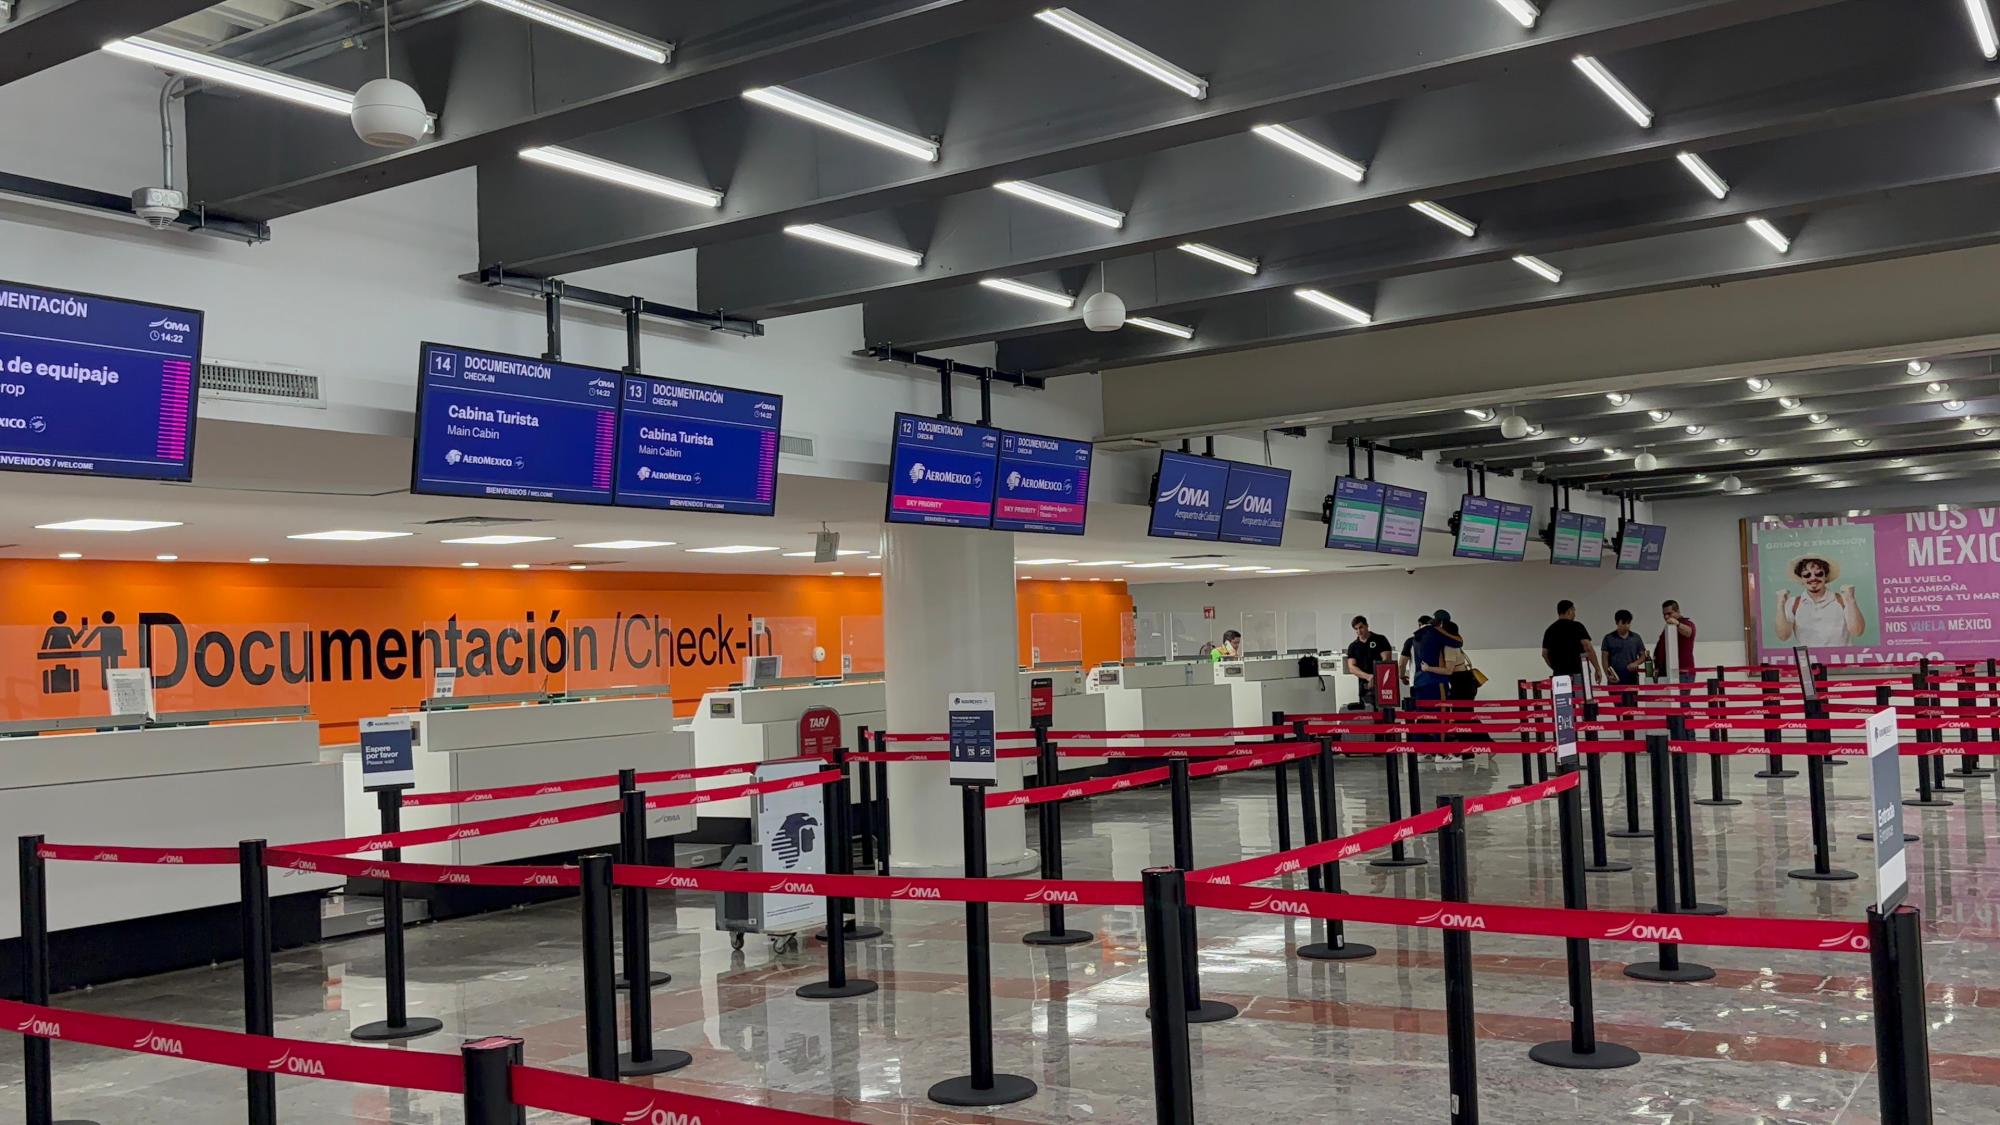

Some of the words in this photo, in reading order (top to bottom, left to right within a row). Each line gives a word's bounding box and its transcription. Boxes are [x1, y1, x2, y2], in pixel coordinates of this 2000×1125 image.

[164, 321, 190, 332] OMA
[161, 333, 184, 343] 14:22
[435, 356, 450, 371] 14
[464, 356, 551, 380] DOCUMENTACIÓN
[8, 357, 32, 374] de
[36, 363, 119, 385] equipaje
[464, 372, 495, 383] CHECK-IN
[1, 383, 25, 397] rop
[598, 380, 614, 389] OMA
[630, 384, 642, 398] 13
[653, 384, 724, 404] DOCUMENTACIÓN
[652, 398, 678, 408] CHECK-IN
[448, 405, 494, 422] Cabina
[498, 410, 539, 427] Turista
[448, 425, 470, 437] Main
[472, 427, 500, 440] Cabin
[903, 422, 912, 433] 12
[918, 422, 964, 436] DOCUMENTACIÓN
[640, 427, 677, 442] Cabina
[679, 431, 714, 446] Turista
[1005, 438, 1012, 448] 11
[1018, 438, 1058, 451] DOCUMENTACIÓN
[639, 444, 658, 455] Main
[660, 446, 682, 458] Cabin
[0, 455, 50, 467] NVENIDOS
[57, 461, 94, 470] WELCOME
[486, 487, 527, 496] BIENVENIDOS
[1178, 487, 1210, 508] OMA
[1244, 496, 1272, 515] OMA
[1883, 576, 1912, 584] DALE
[1914, 575, 1952, 583] VUELO
[1910, 582, 1968, 592] CAMPAÑA
[1884, 595, 1943, 604] LLEVEMOS
[1884, 605, 1909, 614] MÁS
[1886, 622, 1907, 632] NOS
[1911, 620, 1944, 632] VUELA
[1948, 618, 1992, 630] MÉXICO
[138, 610, 598, 688] Documentación
[809, 717, 825, 728] TAR
[540, 816, 559, 826] OMA
[459, 828, 480, 838] OMA
[1400, 826, 1414, 837] OMA
[370, 841, 393, 850] OMA
[1344, 844, 1361, 854] OMA
[40, 850, 56, 858] OMA
[102, 853, 118, 862] OMA
[166, 854, 184, 864] OMA
[298, 860, 316, 870] OMA
[1282, 859, 1300, 871] OMA
[370, 868, 390, 878] OMA
[450, 874, 470, 884] OMA
[536, 875, 558, 885] OMA
[670, 876, 698, 888] OMA
[784, 882, 815, 894] OMA
[908, 887, 941, 899] OMA
[1043, 890, 1078, 902] OMA
[1270, 900, 1310, 914] OMA
[1440, 914, 1486, 929] OMA
[1632, 924, 1683, 940] OMA
[33, 1020, 60, 1037] OMA
[150, 1037, 183, 1054] OMA
[288, 1058, 325, 1076] OMA
